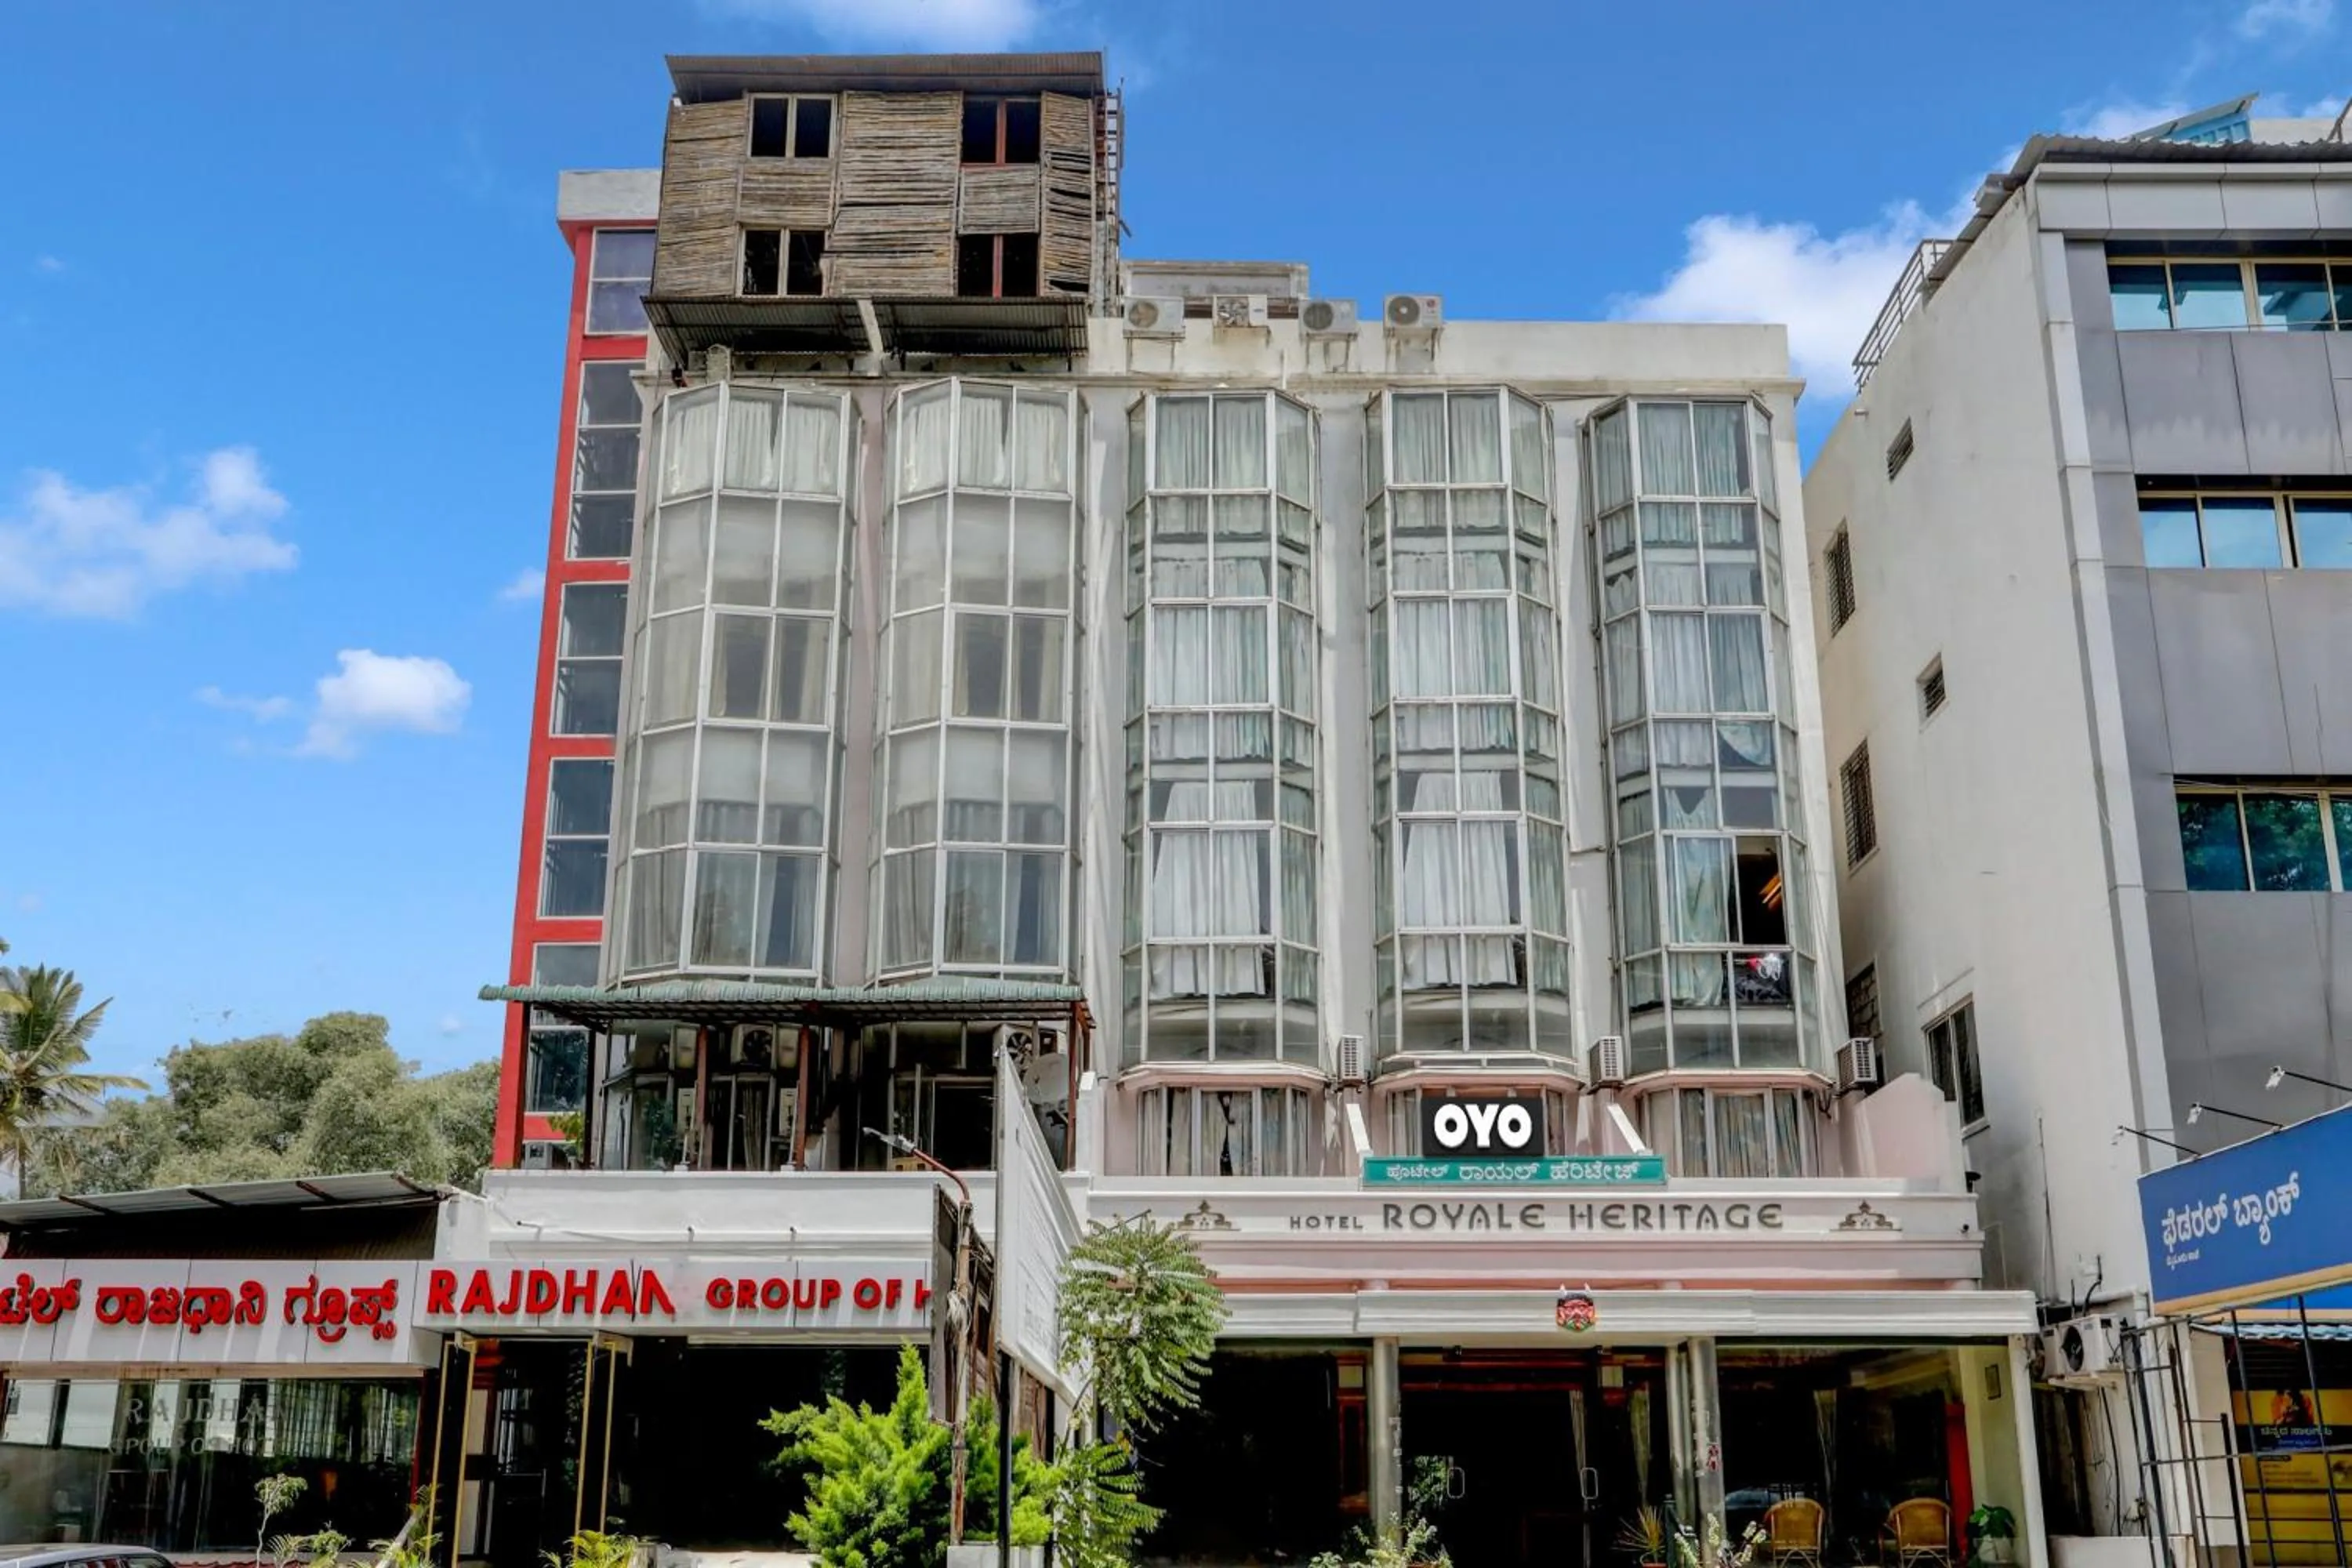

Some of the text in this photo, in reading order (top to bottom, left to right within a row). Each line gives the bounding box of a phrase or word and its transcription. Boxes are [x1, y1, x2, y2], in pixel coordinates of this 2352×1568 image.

[1434, 1103, 1532, 1149] OYO
[1459, 1162, 1539, 1180] ರಾಯಲ್
[1290, 1203, 1783, 1230] HOTEL ROYALE HERITAGE
[2161, 1171, 2300, 1253] ಫೆಡರಲ್ ಬ್ಯಾಂಕ್
[0, 1272, 399, 1343] ಟೆಲ್ ರಾಜಧಾನಿ ಗ್ರೂಪ್ಸ್
[706, 1277, 842, 1310] GROUP
[853, 1278, 903, 1310] OF
